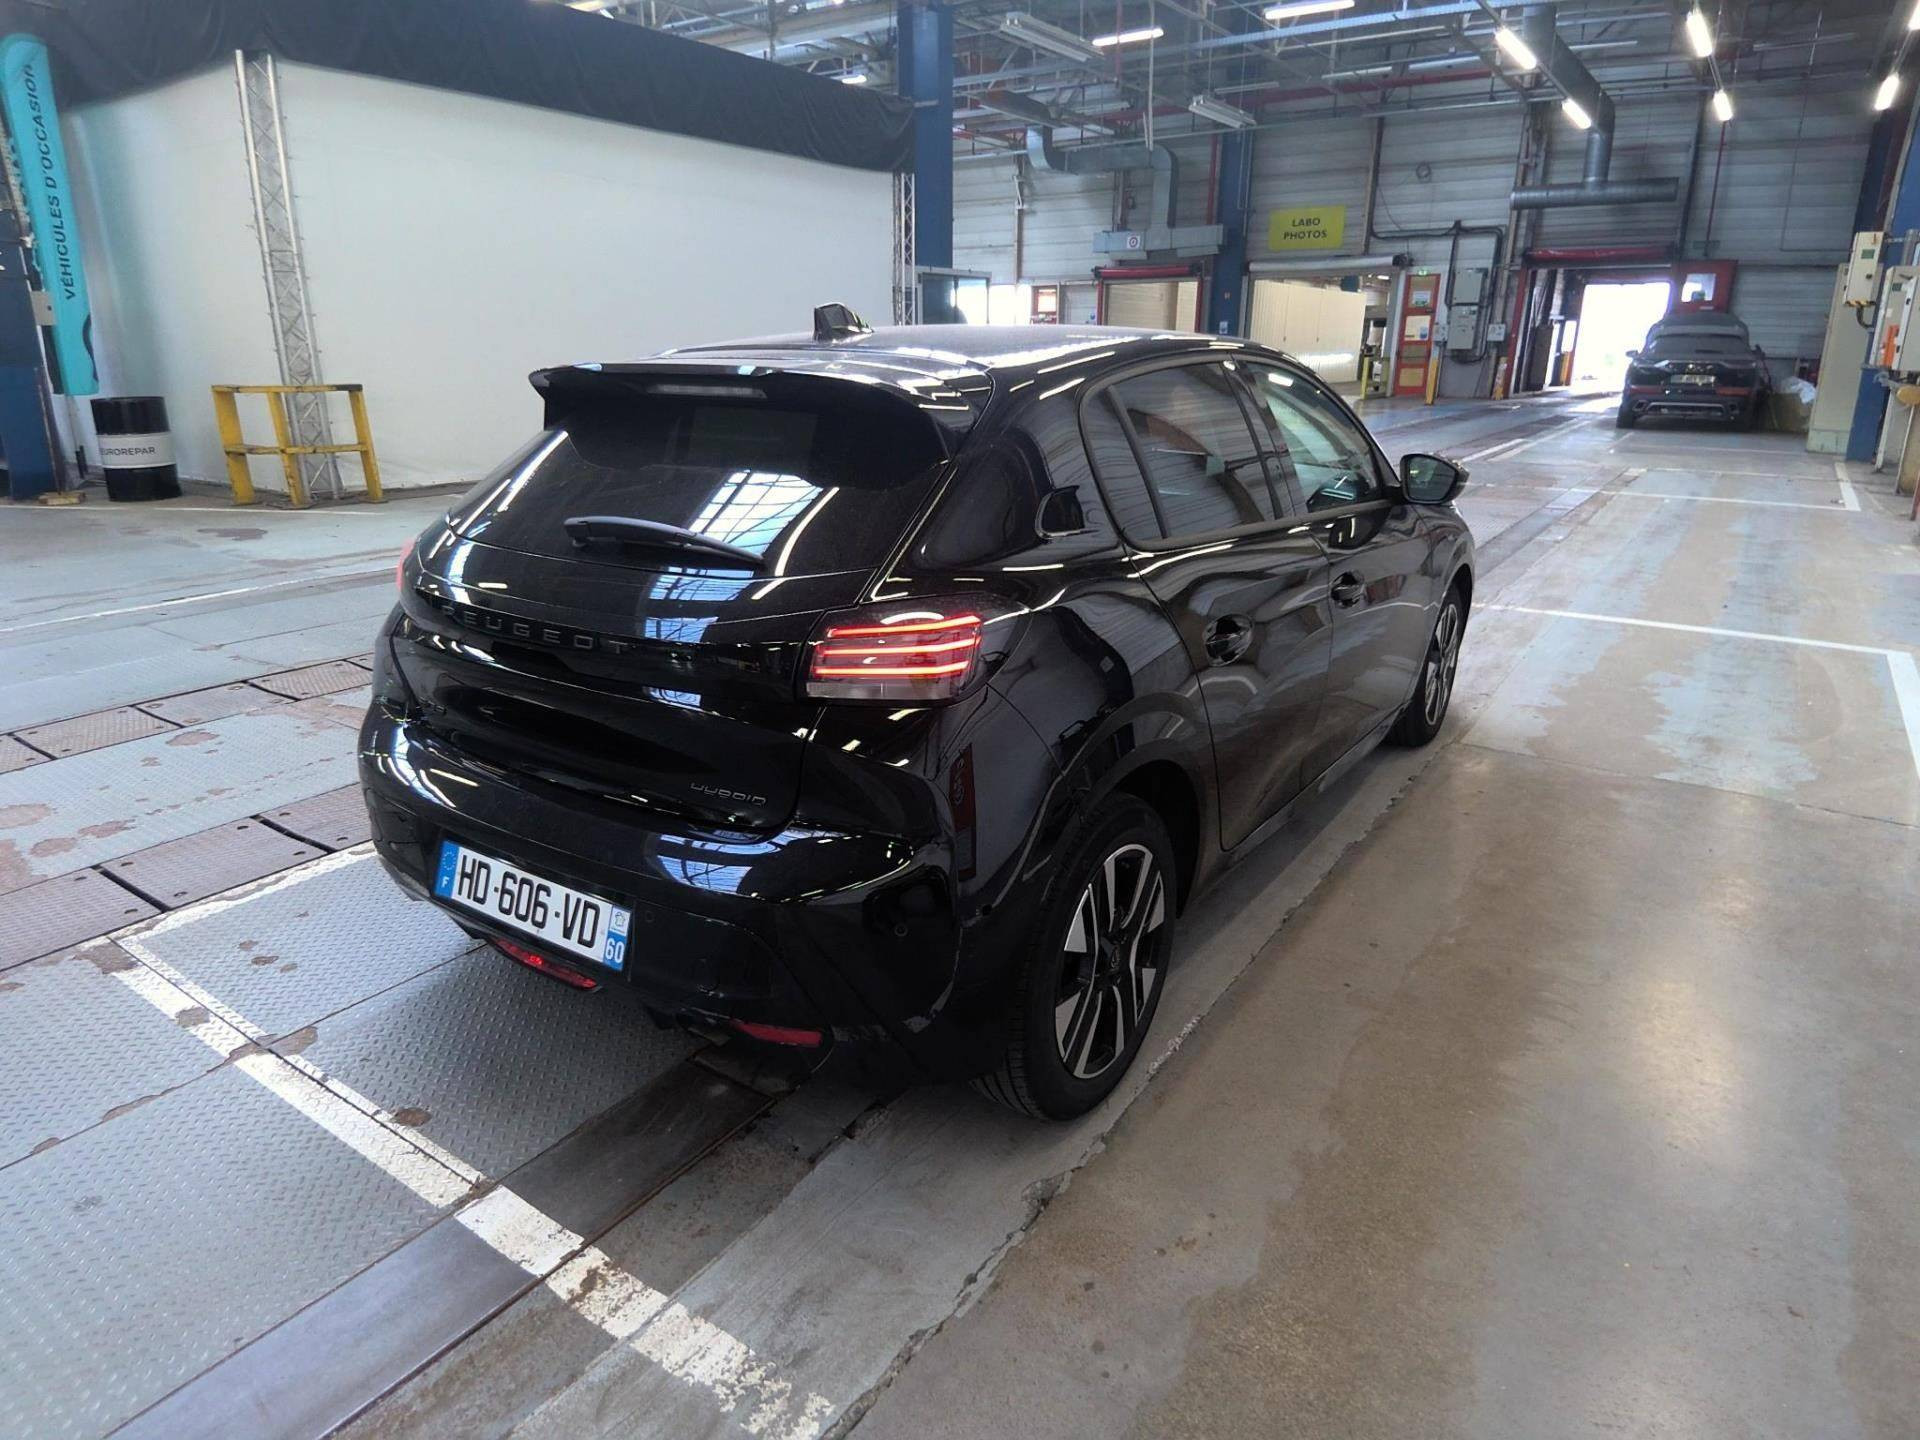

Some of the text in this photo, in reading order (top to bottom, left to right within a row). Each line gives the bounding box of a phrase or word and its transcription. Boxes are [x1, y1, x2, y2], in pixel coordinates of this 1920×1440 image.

[1292, 217, 1321, 227] LABO
[1283, 229, 1328, 240] PHOTOS
[48, 194, 76, 300] VÉHICULES
[441, 876, 450, 888] F
[457, 854, 600, 949] HD-606-VD
[605, 937, 625, 963] 60
